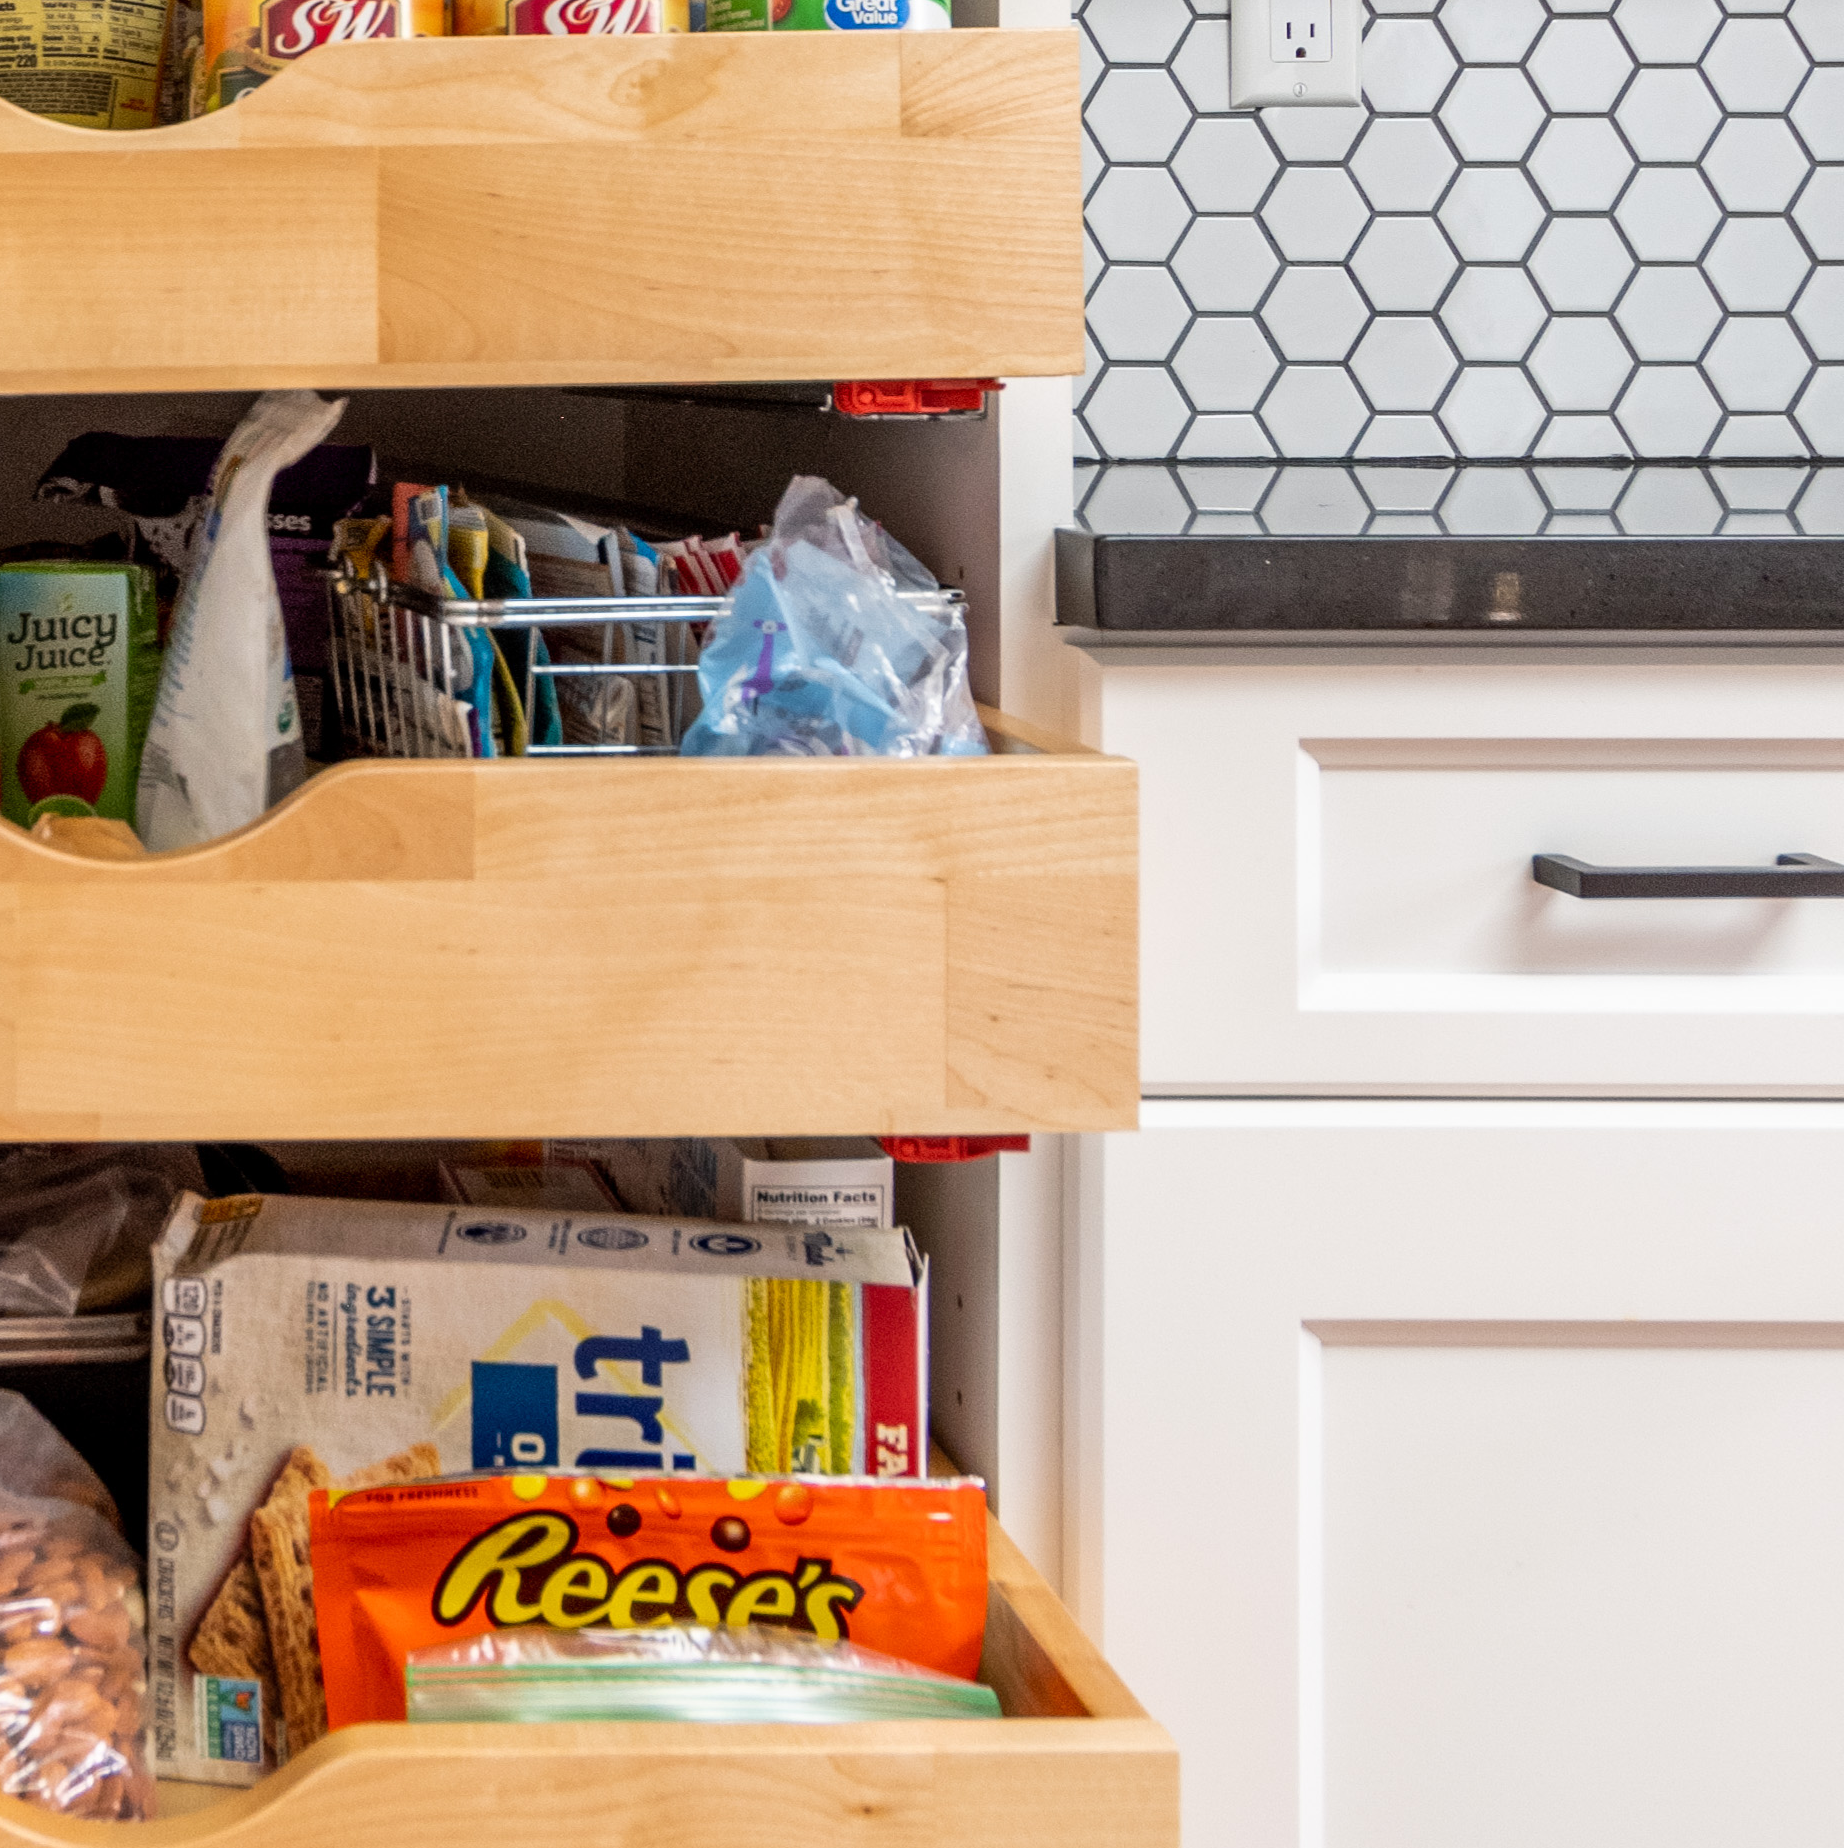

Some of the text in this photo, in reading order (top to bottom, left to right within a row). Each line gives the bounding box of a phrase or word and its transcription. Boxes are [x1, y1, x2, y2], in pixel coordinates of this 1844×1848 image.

[852, 10, 899, 25] Value
[7, 612, 118, 647] Juicy
[15, 644, 106, 671] Juice
[757, 1192, 876, 1204] Nutrition Facts
[340, 1282, 363, 1398] ingredients
[366, 1285, 397, 1398] 3 SIMPLE
[433, 1509, 865, 1645] Reese's
